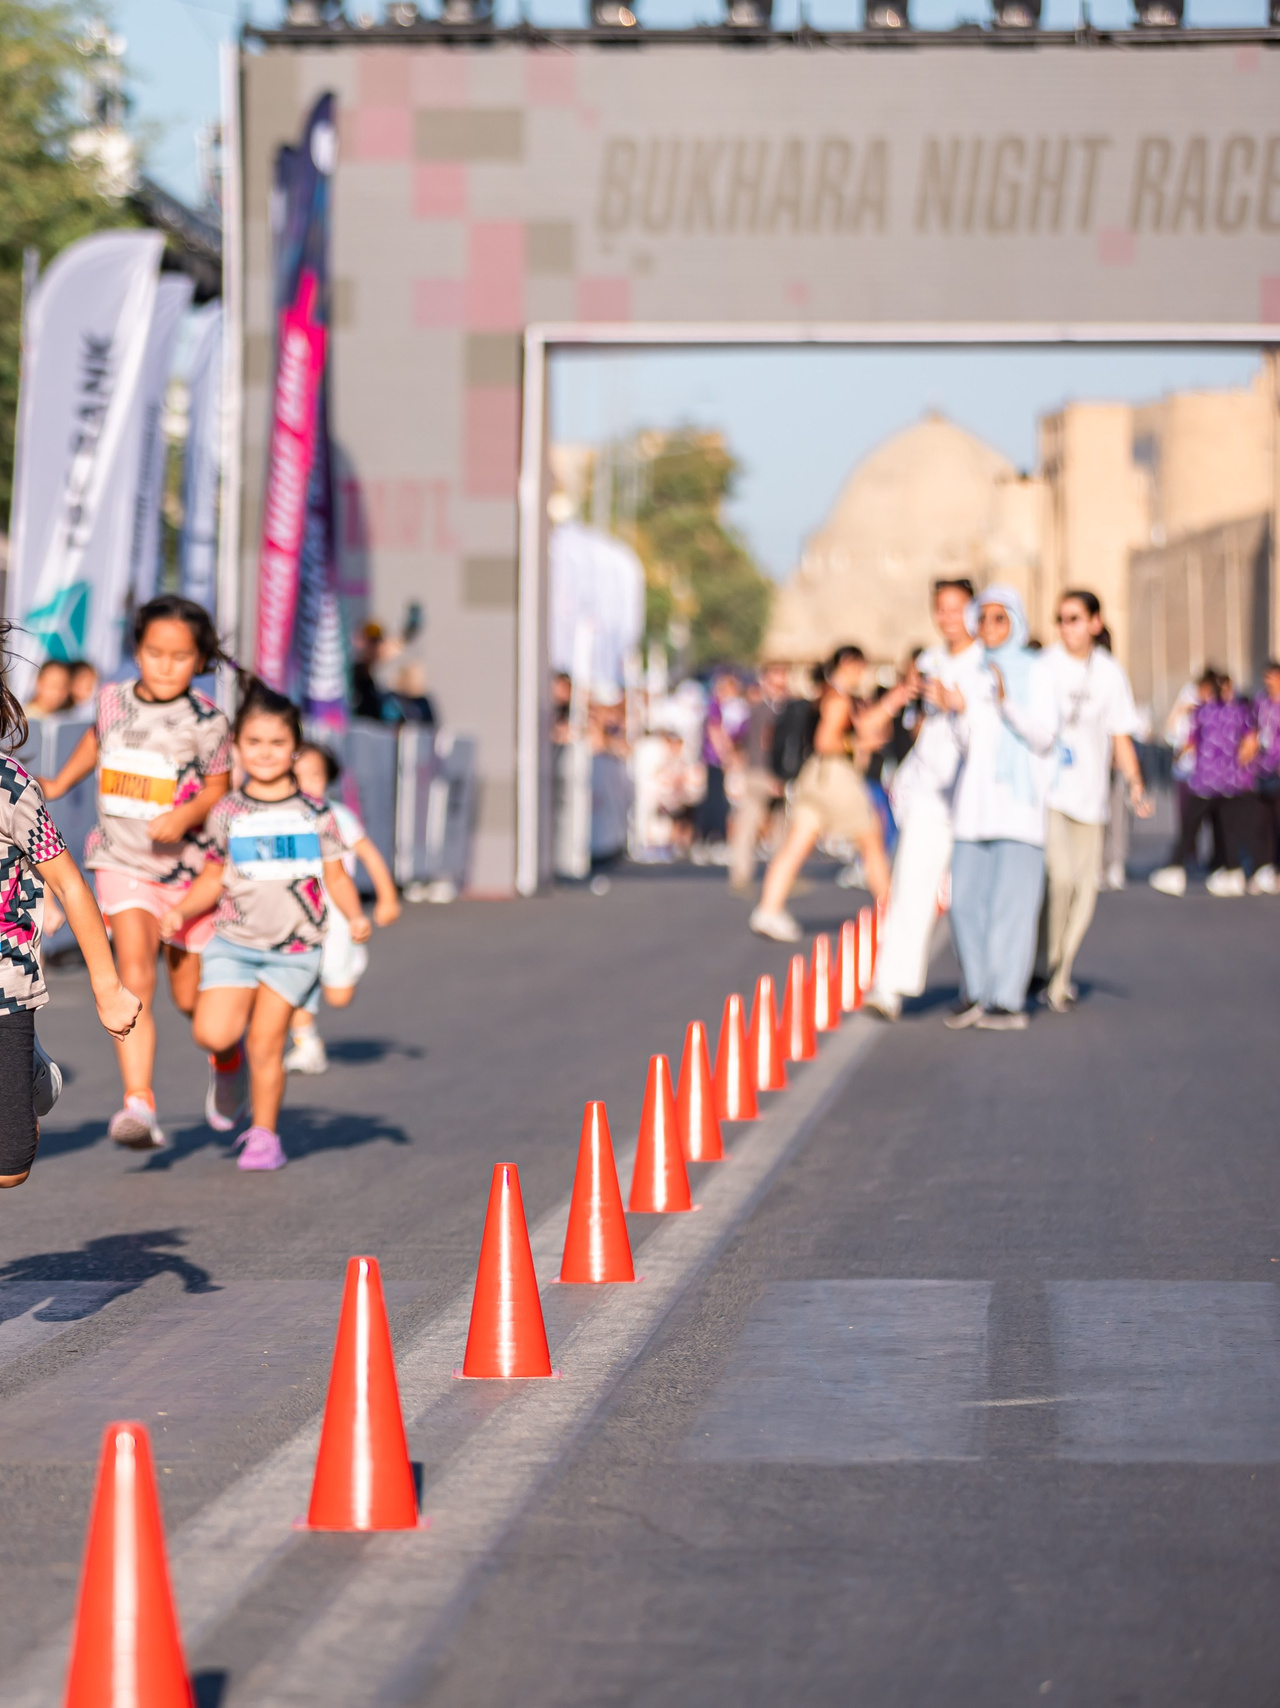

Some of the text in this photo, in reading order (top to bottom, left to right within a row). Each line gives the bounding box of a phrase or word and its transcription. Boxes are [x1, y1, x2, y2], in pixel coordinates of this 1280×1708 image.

[598, 132, 1280, 236] BUKHARA NIGHT RACE
